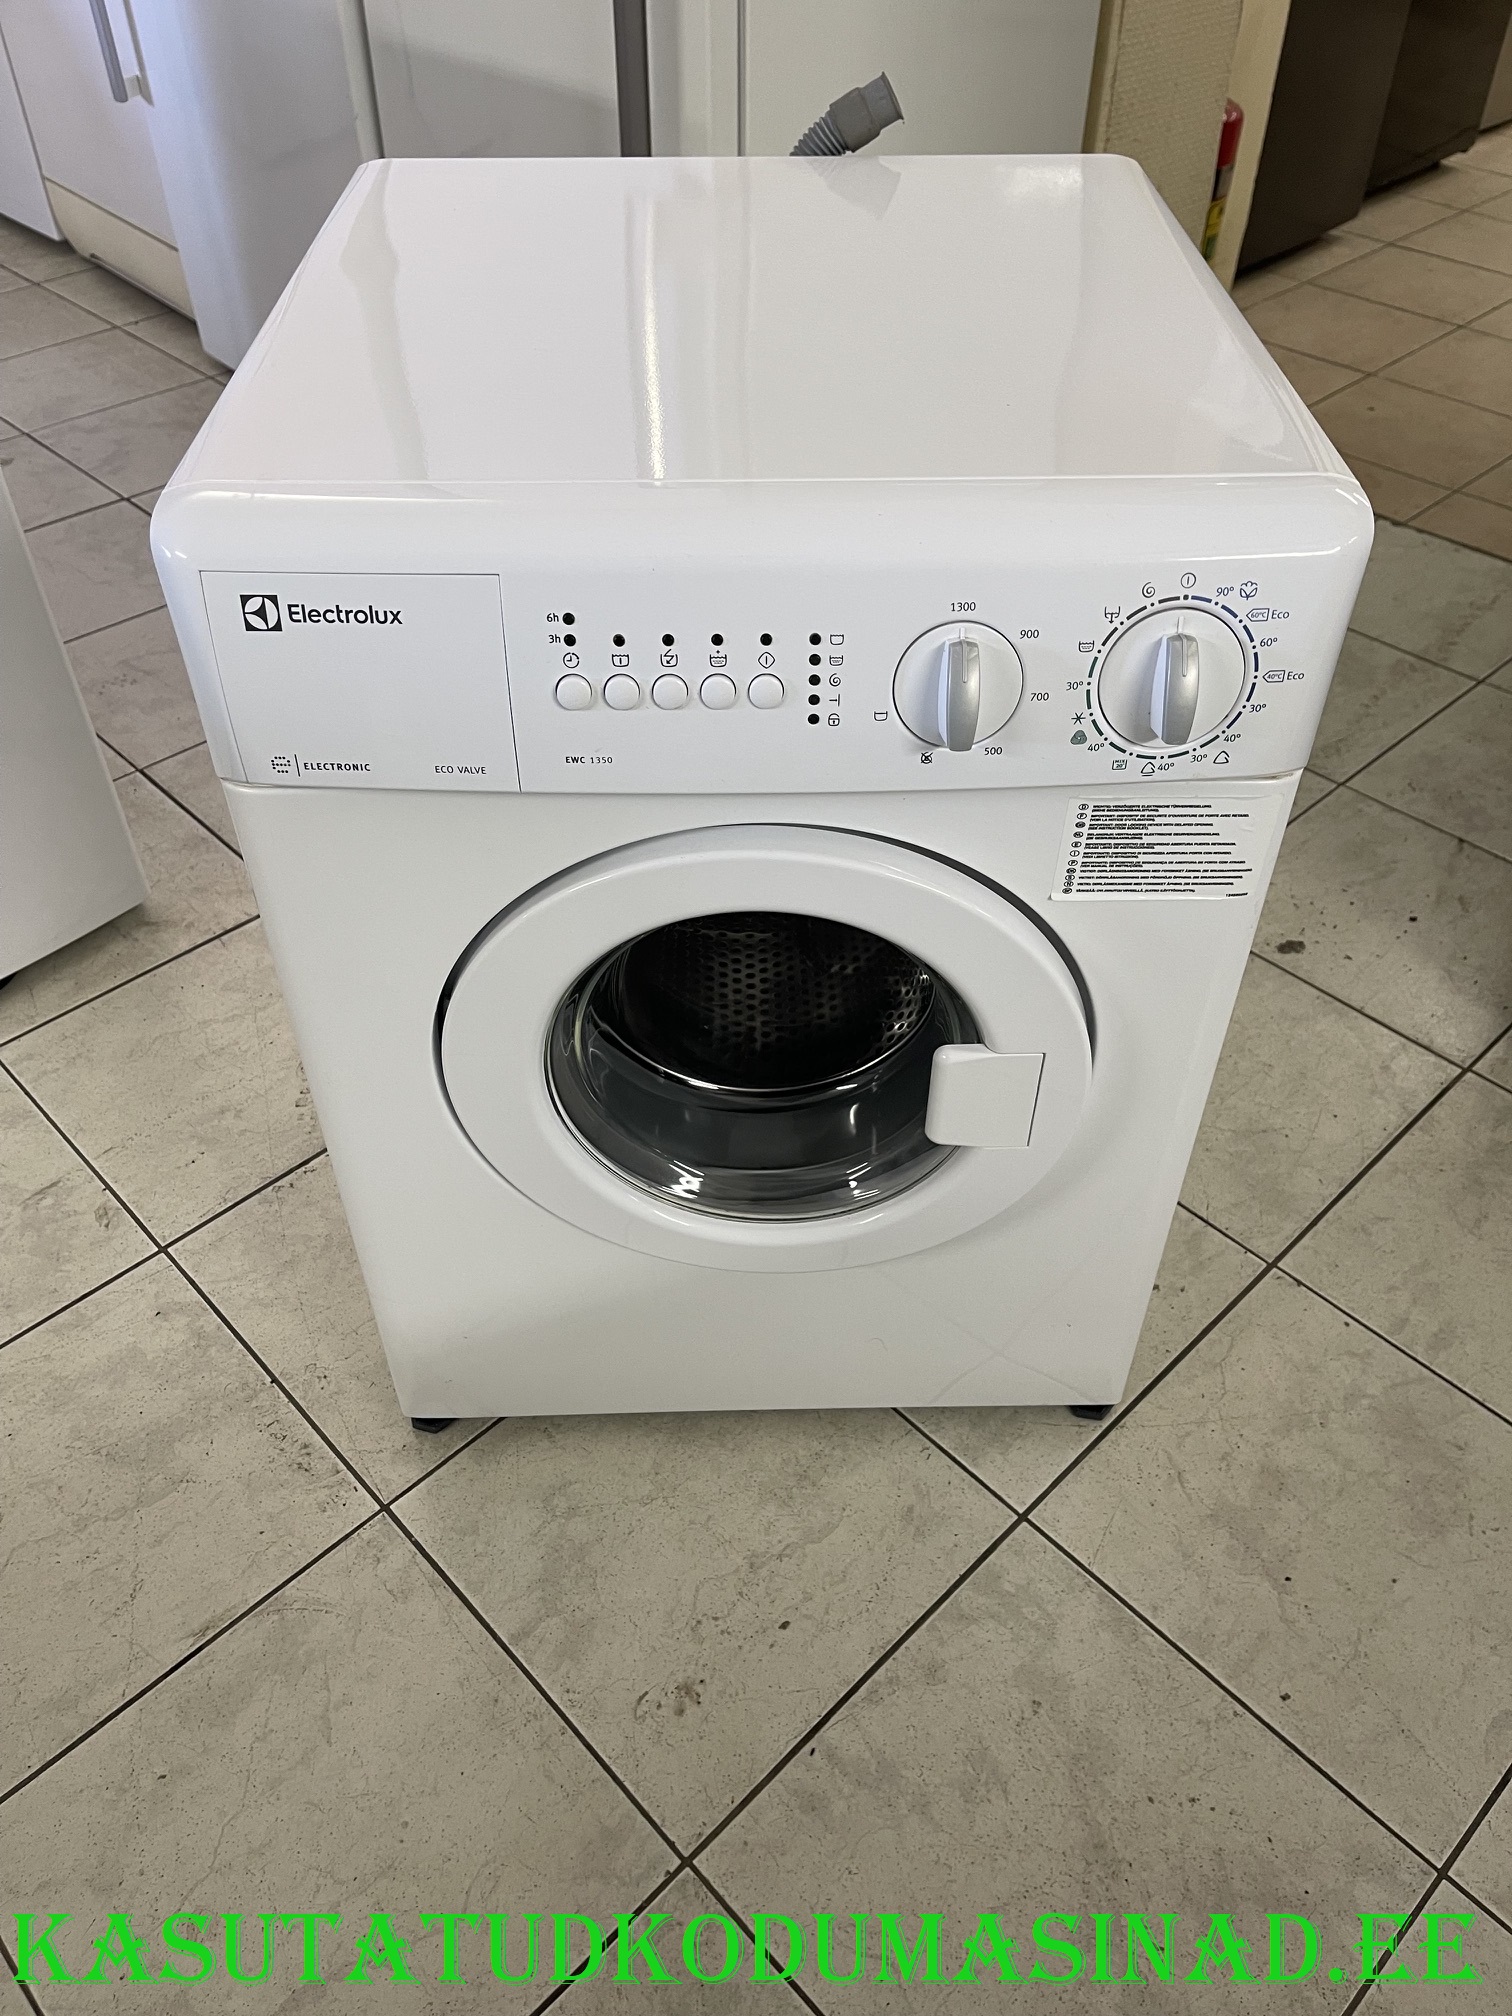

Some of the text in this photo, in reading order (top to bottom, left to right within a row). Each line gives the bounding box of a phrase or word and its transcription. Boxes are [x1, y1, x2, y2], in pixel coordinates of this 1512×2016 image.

[951, 602, 976, 612] 1300
[287, 604, 403, 624] Electrolux
[547, 613, 559, 622] 6h
[1271, 610, 1289, 619] Eco
[549, 634, 561, 643] 3h
[1020, 629, 1039, 639] 900
[1287, 671, 1304, 680] Eco
[1031, 692, 1049, 701] 700
[984, 747, 1002, 755] 500
[304, 763, 370, 771] ELECTRONIC
[457, 766, 486, 774] VALVE
